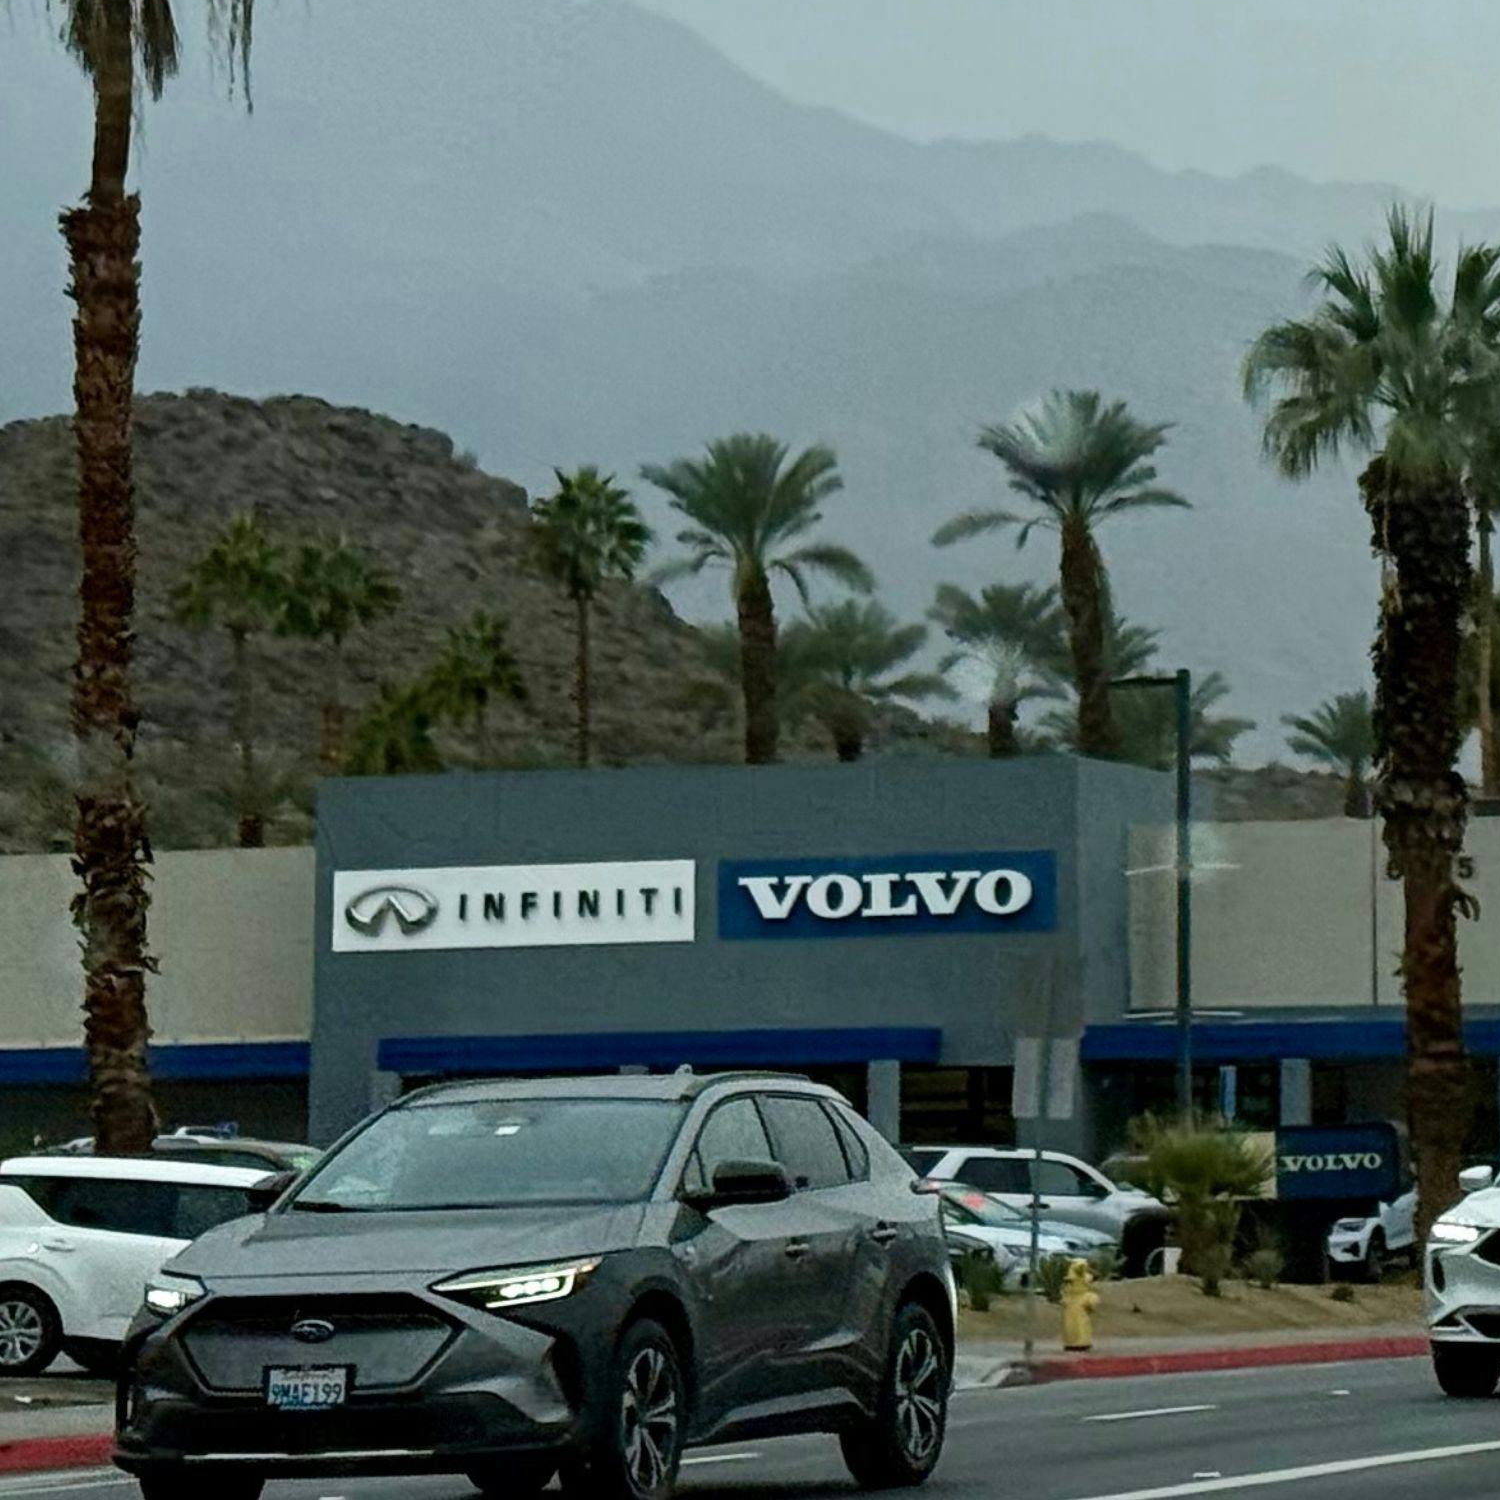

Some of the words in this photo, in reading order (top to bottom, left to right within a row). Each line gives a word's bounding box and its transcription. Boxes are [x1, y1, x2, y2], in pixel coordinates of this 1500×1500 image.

[459, 886, 682, 921] INFINITI
[738, 869, 1032, 919] VOLVO
[1280, 1152, 1382, 1172] VOLVO
